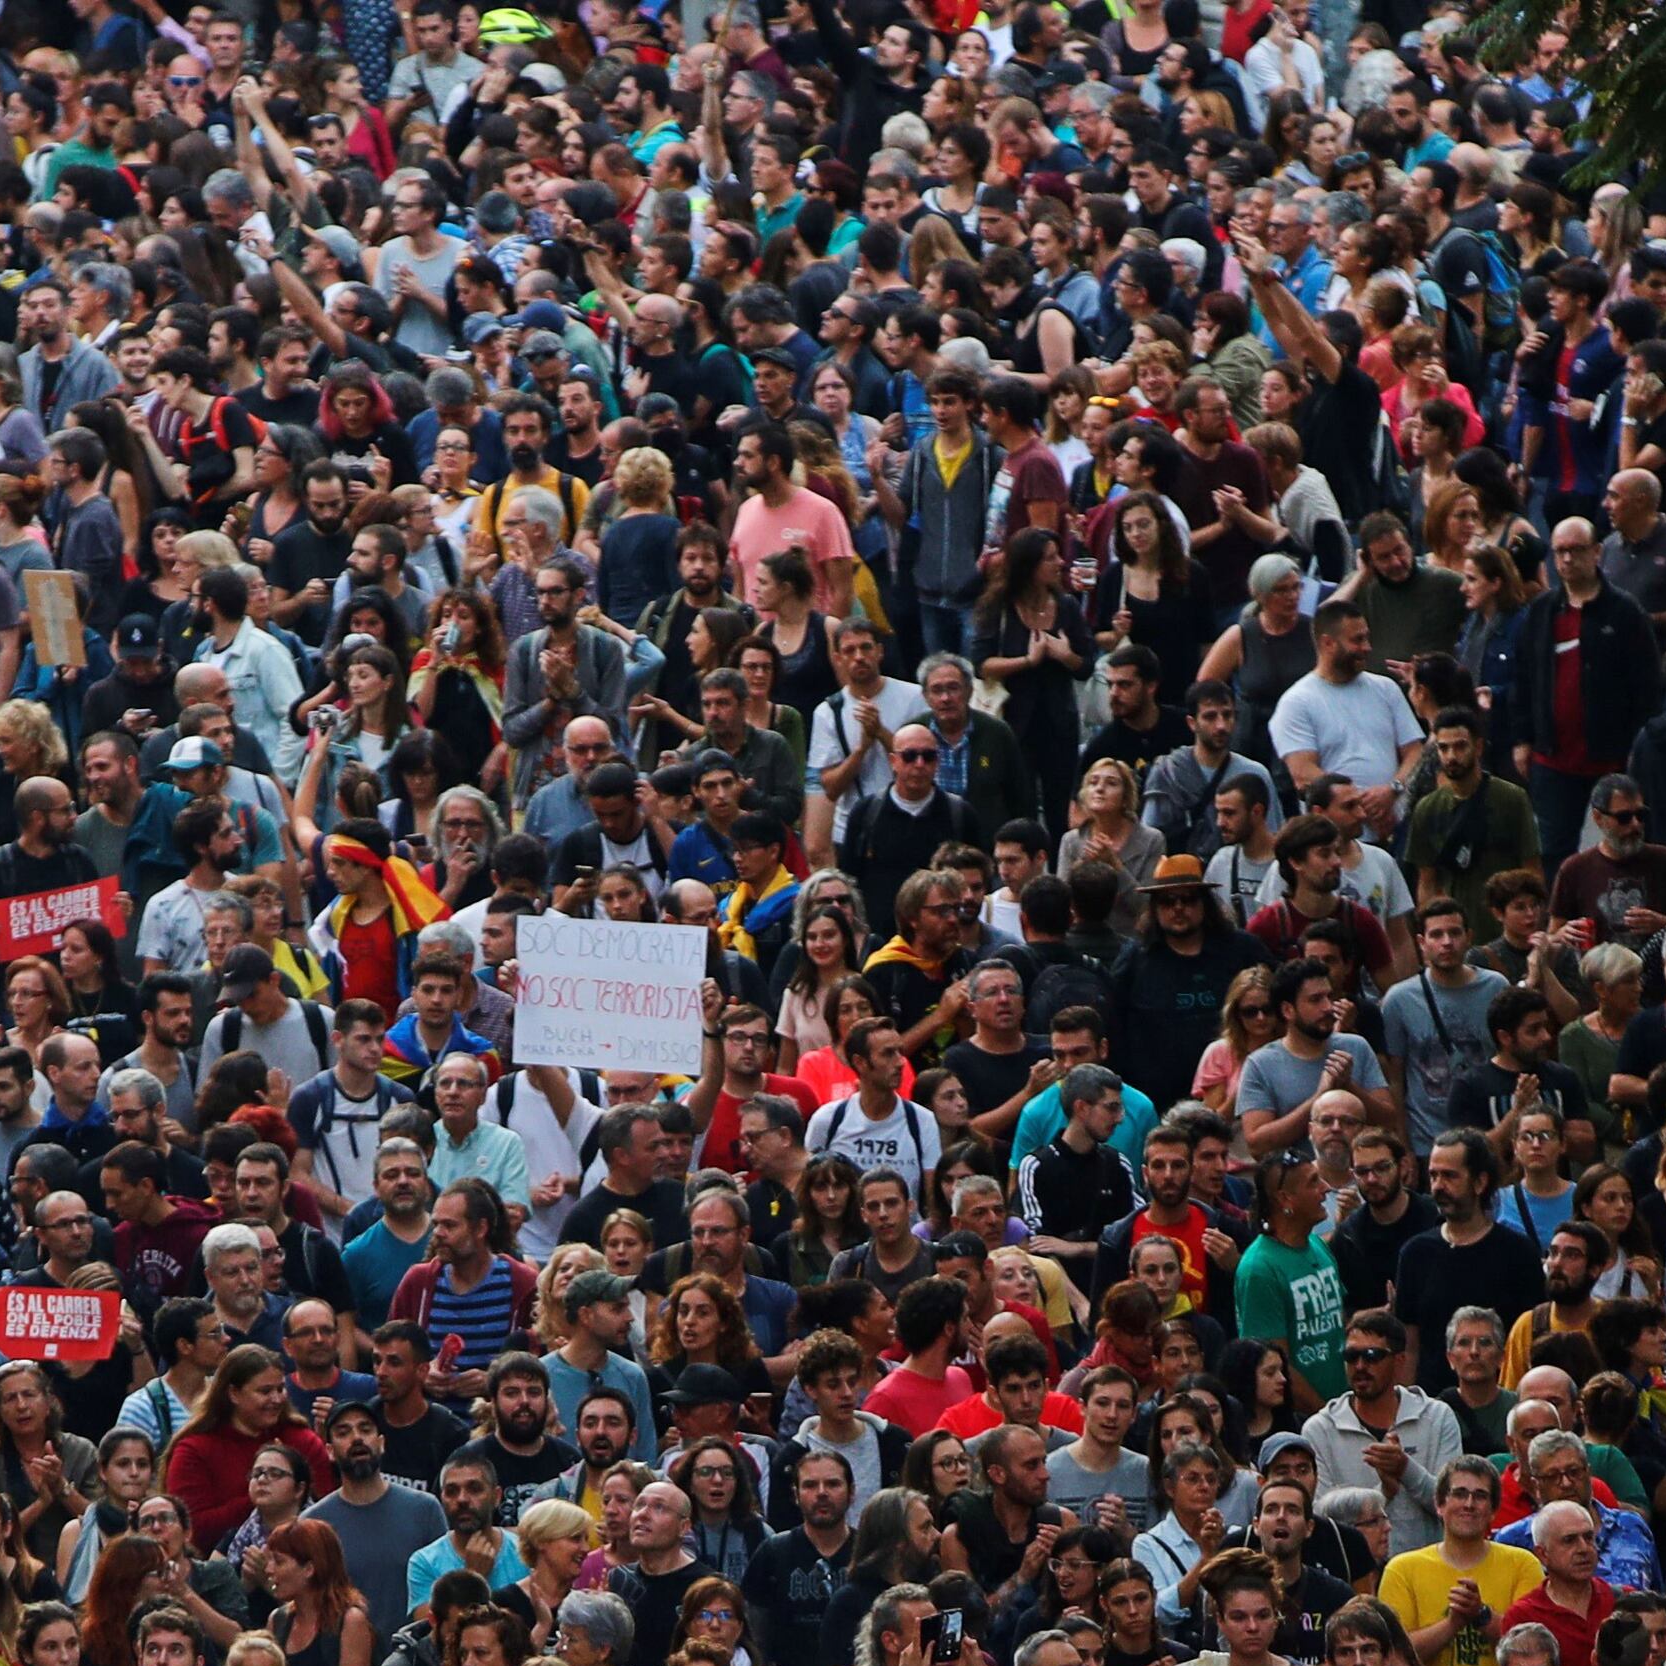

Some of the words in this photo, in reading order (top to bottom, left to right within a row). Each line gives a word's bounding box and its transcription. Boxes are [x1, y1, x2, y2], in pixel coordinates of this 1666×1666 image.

[50, 885, 99, 909] CARRER
[522, 922, 569, 957] SOC
[577, 926, 704, 967] DEMOCRATA
[513, 974, 544, 1006] NO
[547, 976, 586, 1010] SOC
[593, 979, 702, 1021] TERRORISTA
[853, 1138, 898, 1156] 1978
[28, 1296, 45, 1313] AL
[48, 1296, 101, 1313] CARRER
[6, 1310, 30, 1324] ON
[33, 1310, 51, 1325] EL
[55, 1311, 101, 1326] POBLE
[6, 1324, 26, 1337] ES
[30, 1324, 100, 1339] DEFENSA
